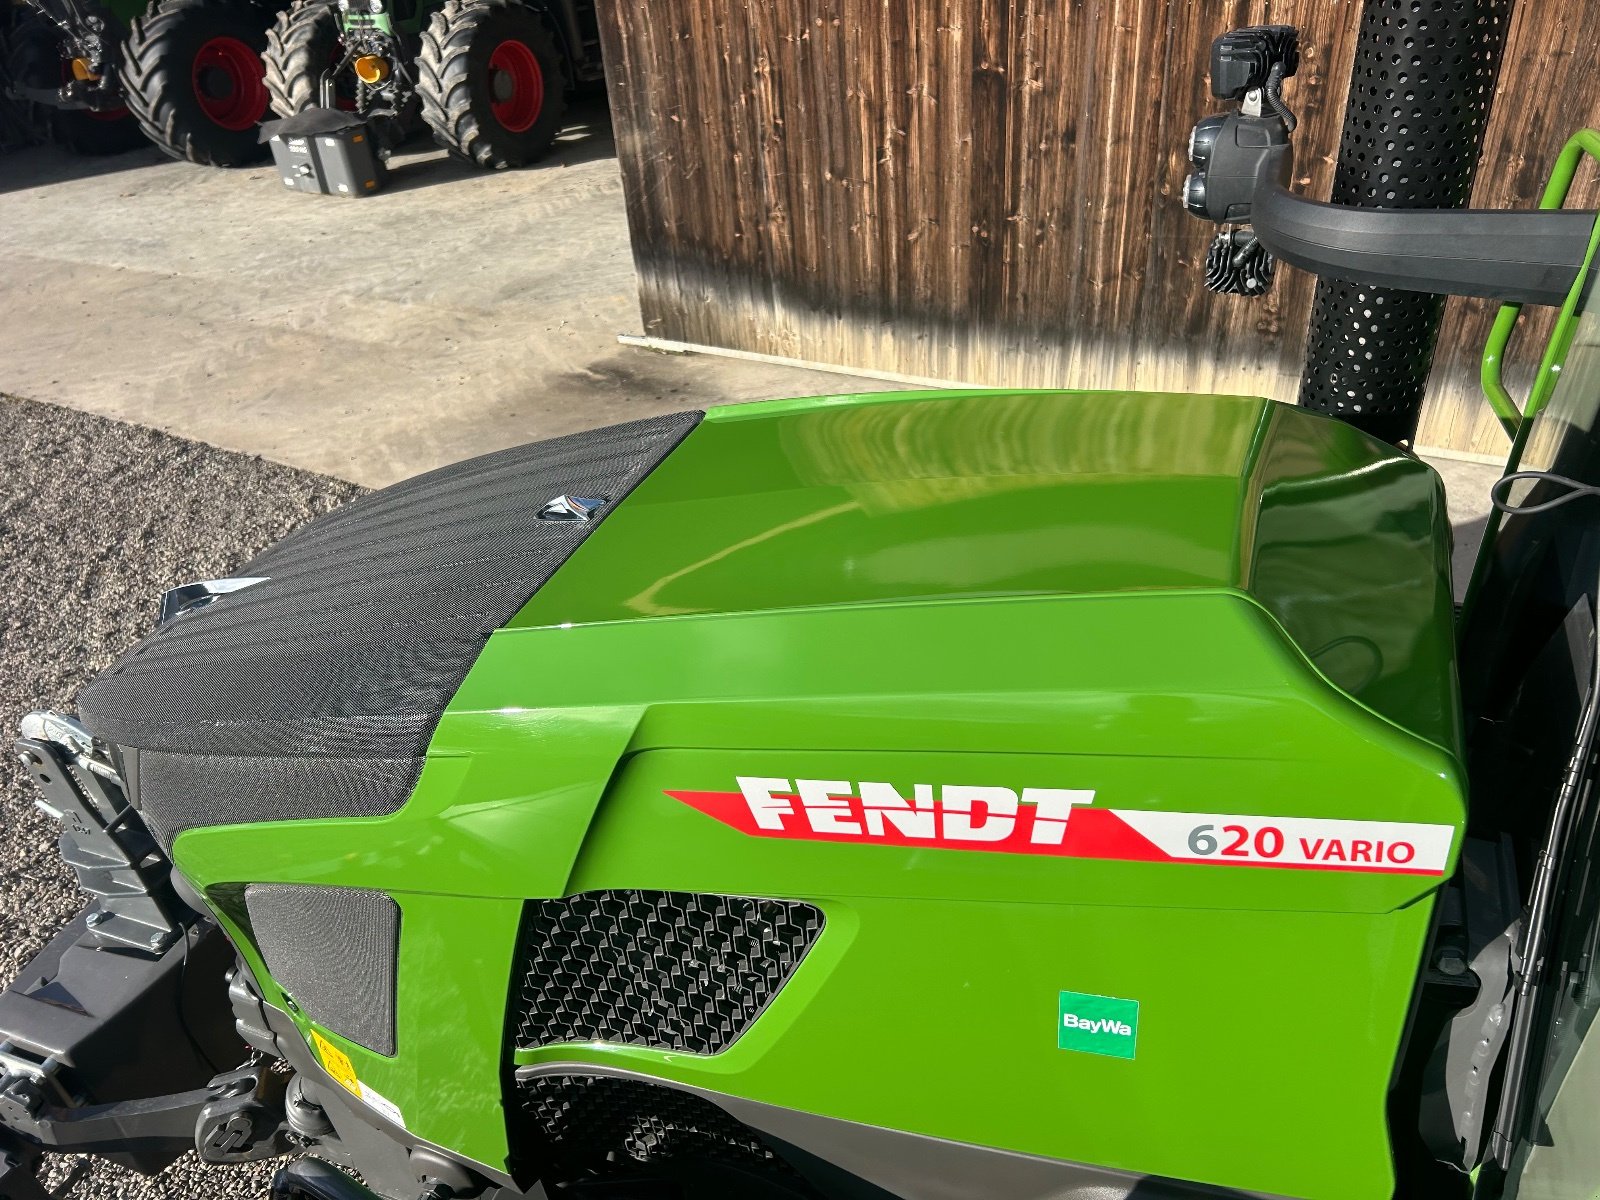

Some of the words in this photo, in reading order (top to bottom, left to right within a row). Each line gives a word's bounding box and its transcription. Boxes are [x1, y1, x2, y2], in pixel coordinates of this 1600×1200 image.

[735, 776, 1096, 845] FENDT
[1187, 824, 1285, 859] 620
[1298, 837, 1416, 865] VARIO
[1063, 1013, 1132, 1036] BayWa
